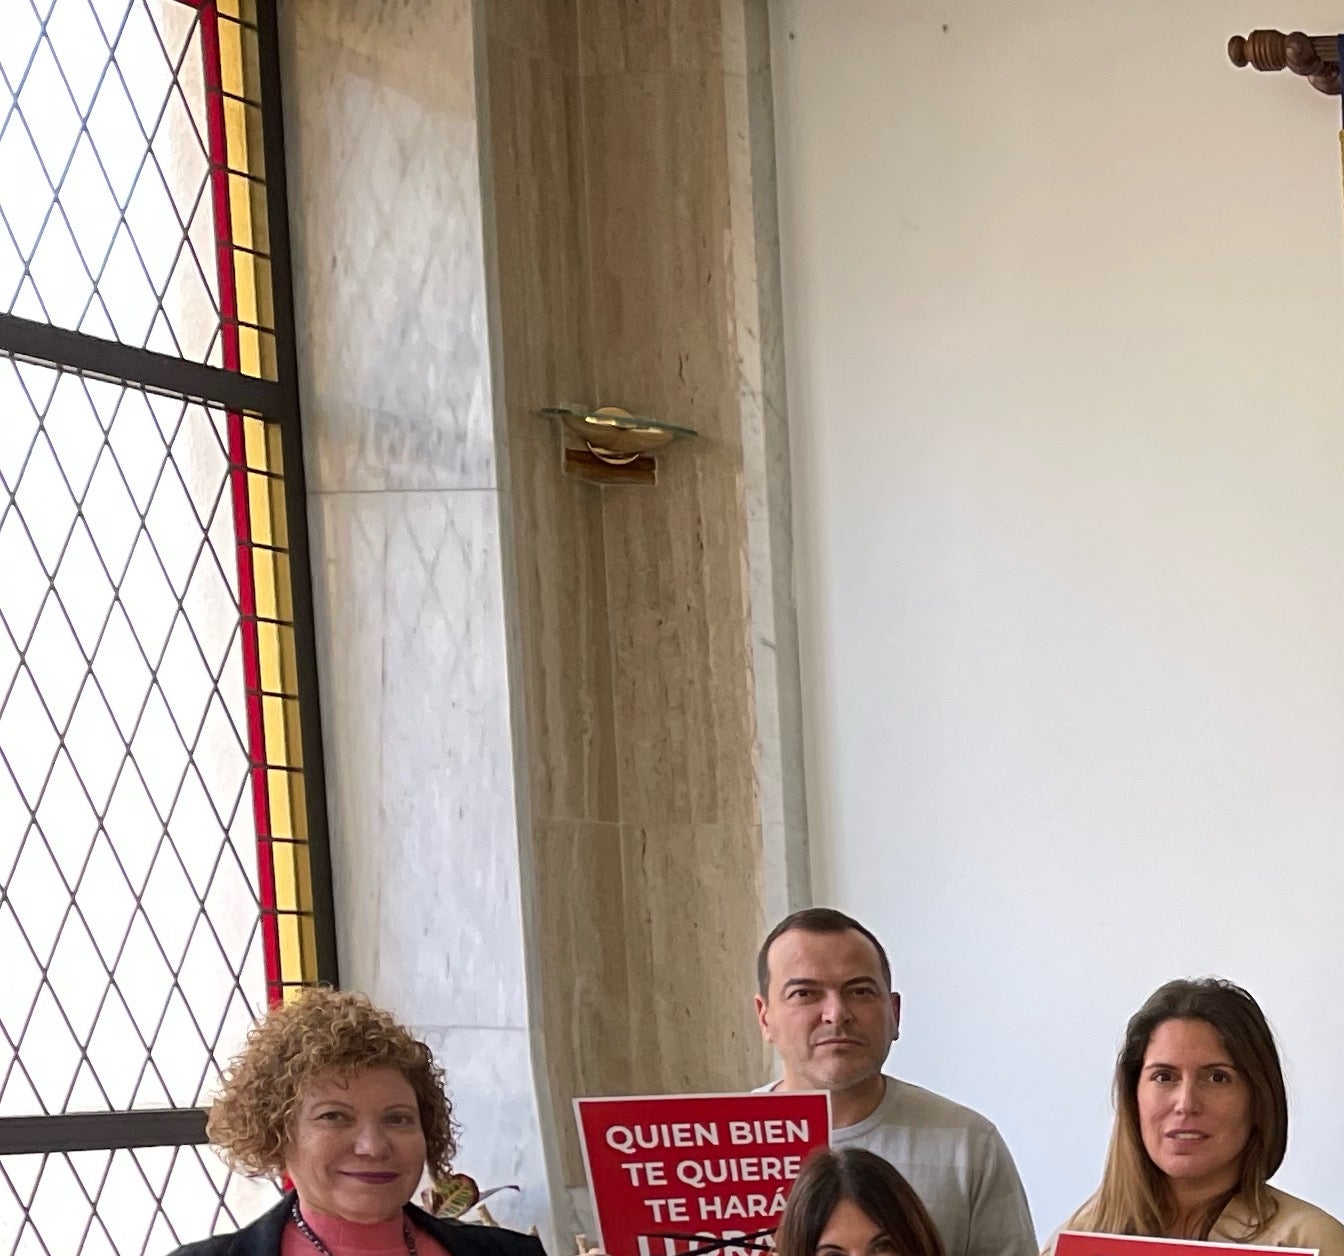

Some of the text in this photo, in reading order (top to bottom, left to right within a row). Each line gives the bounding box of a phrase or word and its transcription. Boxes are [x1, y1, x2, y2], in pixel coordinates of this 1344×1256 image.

[606, 1120, 810, 1154] QUIEN BIEN
[622, 1156, 801, 1188] TE QUIERE
[644, 1199, 690, 1223] TE
